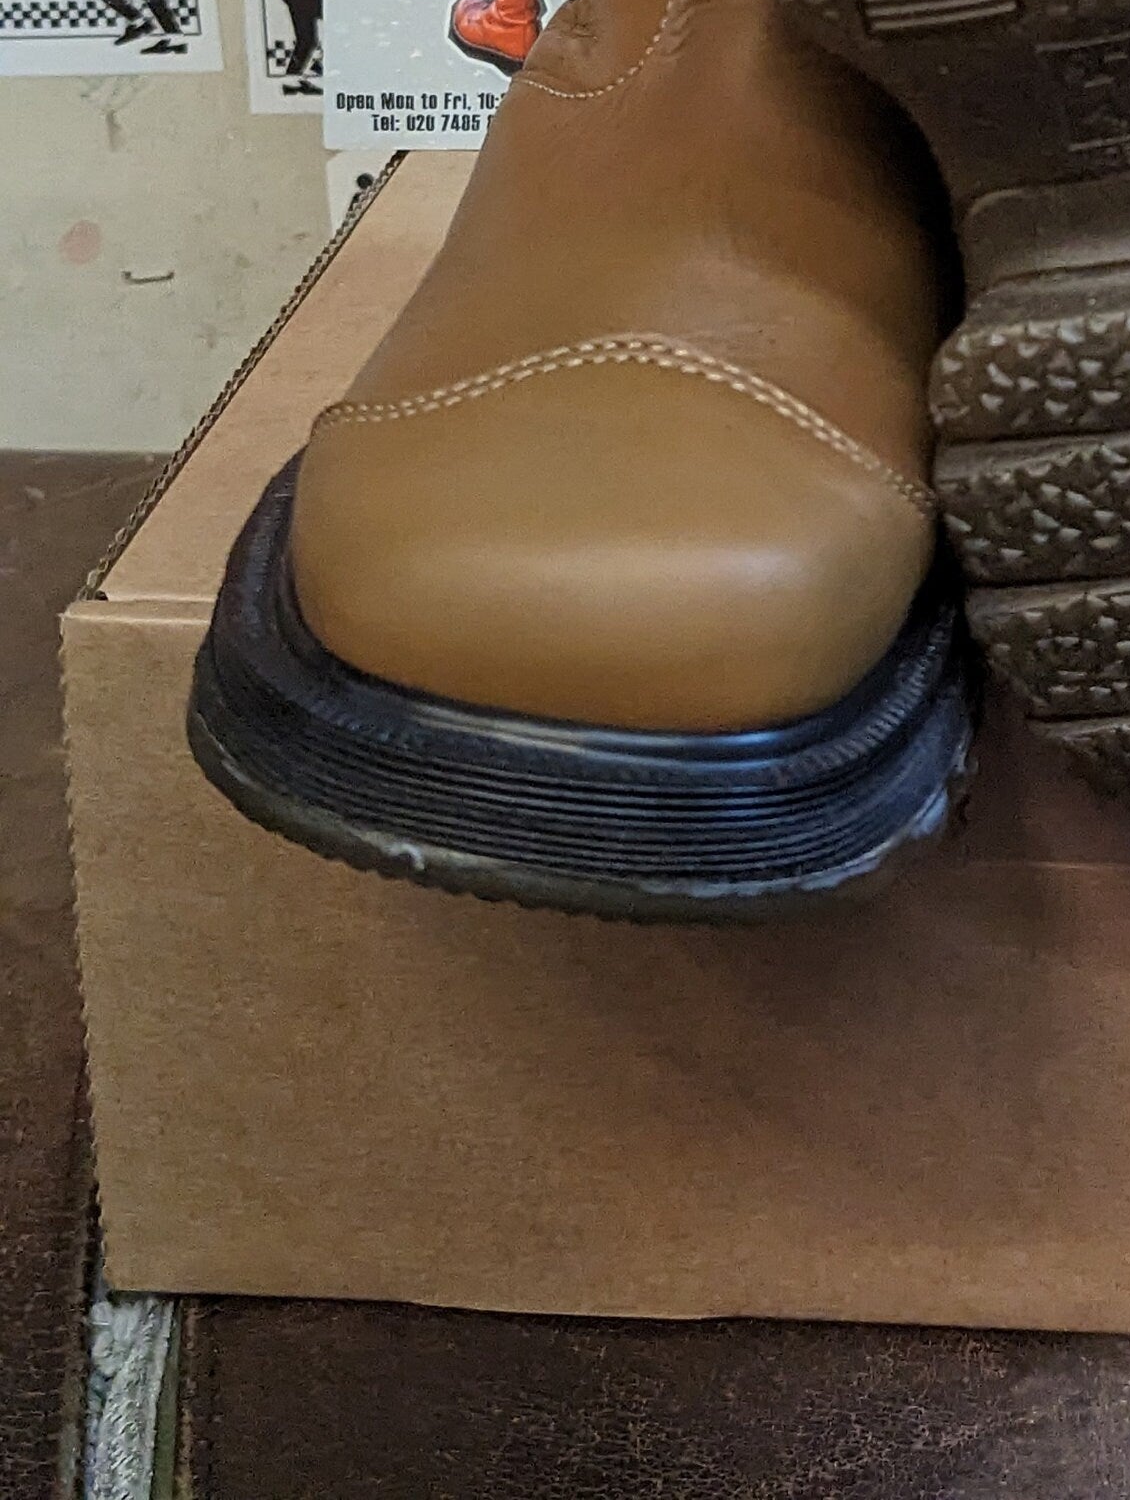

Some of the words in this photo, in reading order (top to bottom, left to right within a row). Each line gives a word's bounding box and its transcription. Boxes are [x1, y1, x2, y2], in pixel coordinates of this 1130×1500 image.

[336, 92, 375, 112] Open
[381, 92, 415, 110] Mon
[421, 92, 438, 110] to
[371, 114, 400, 132] Tel:
[406, 114, 435, 132] 020
[441, 114, 481, 132] 7485
